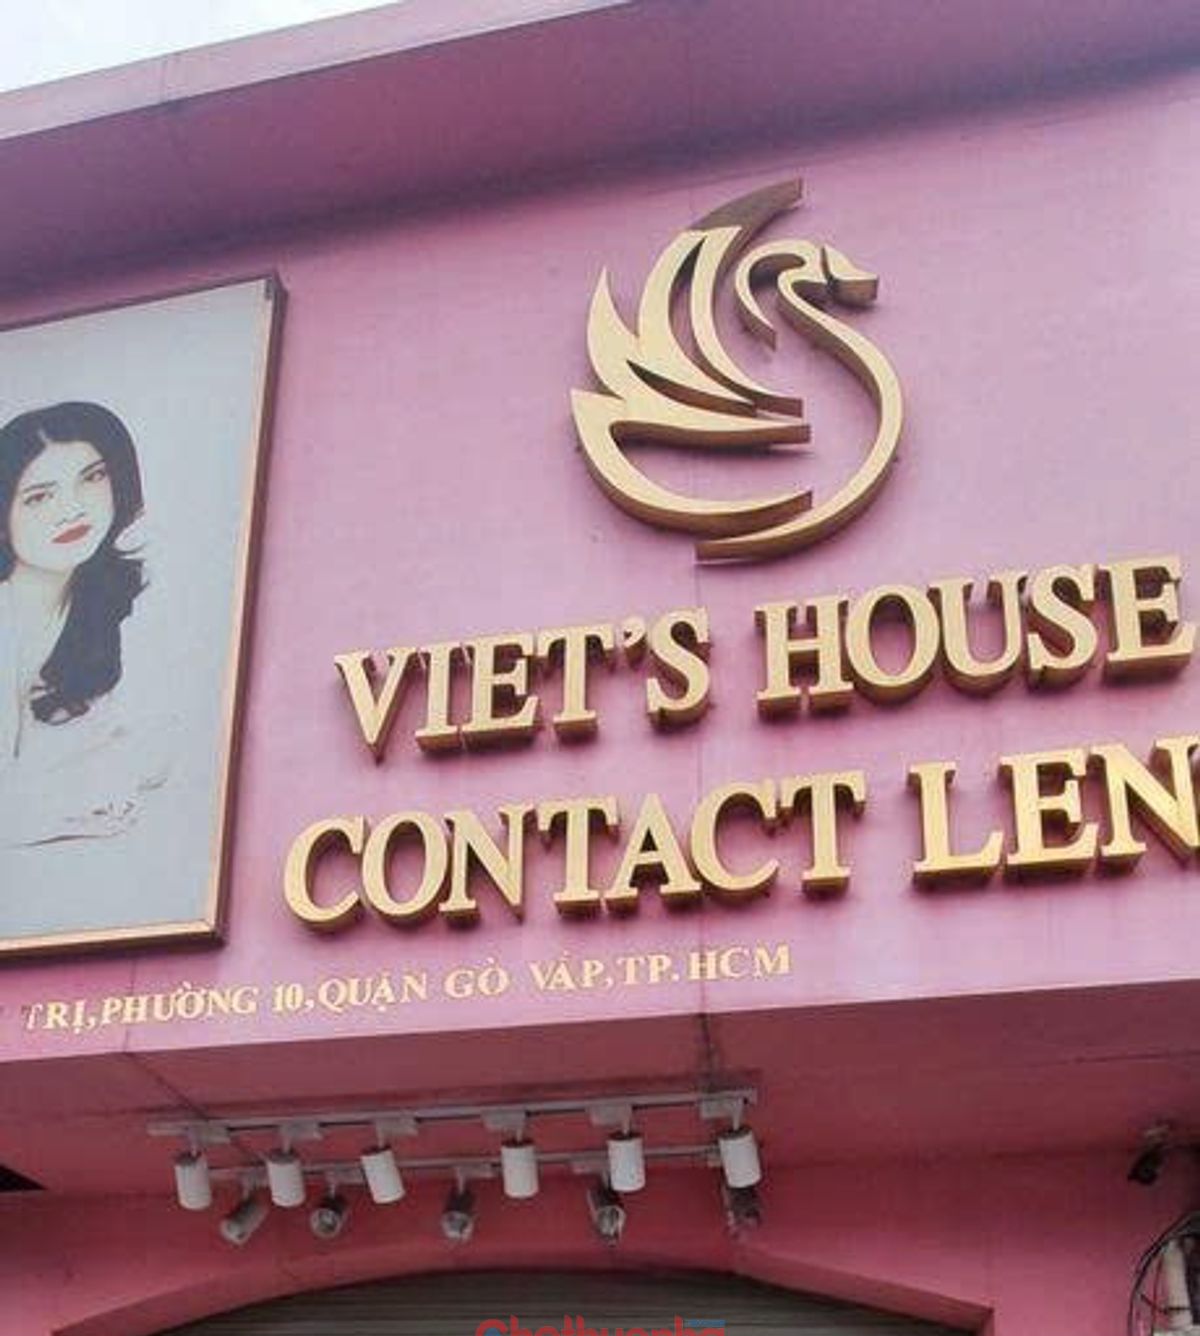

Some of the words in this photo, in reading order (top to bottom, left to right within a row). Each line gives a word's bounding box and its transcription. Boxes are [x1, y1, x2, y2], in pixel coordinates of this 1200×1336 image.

[334, 608, 711, 758] VIET'S
[756, 556, 1195, 716] HOUSE
[283, 770, 866, 926] CONTACT
[907, 736, 1200, 884] LEN
[444, 956, 510, 999] GÒ
